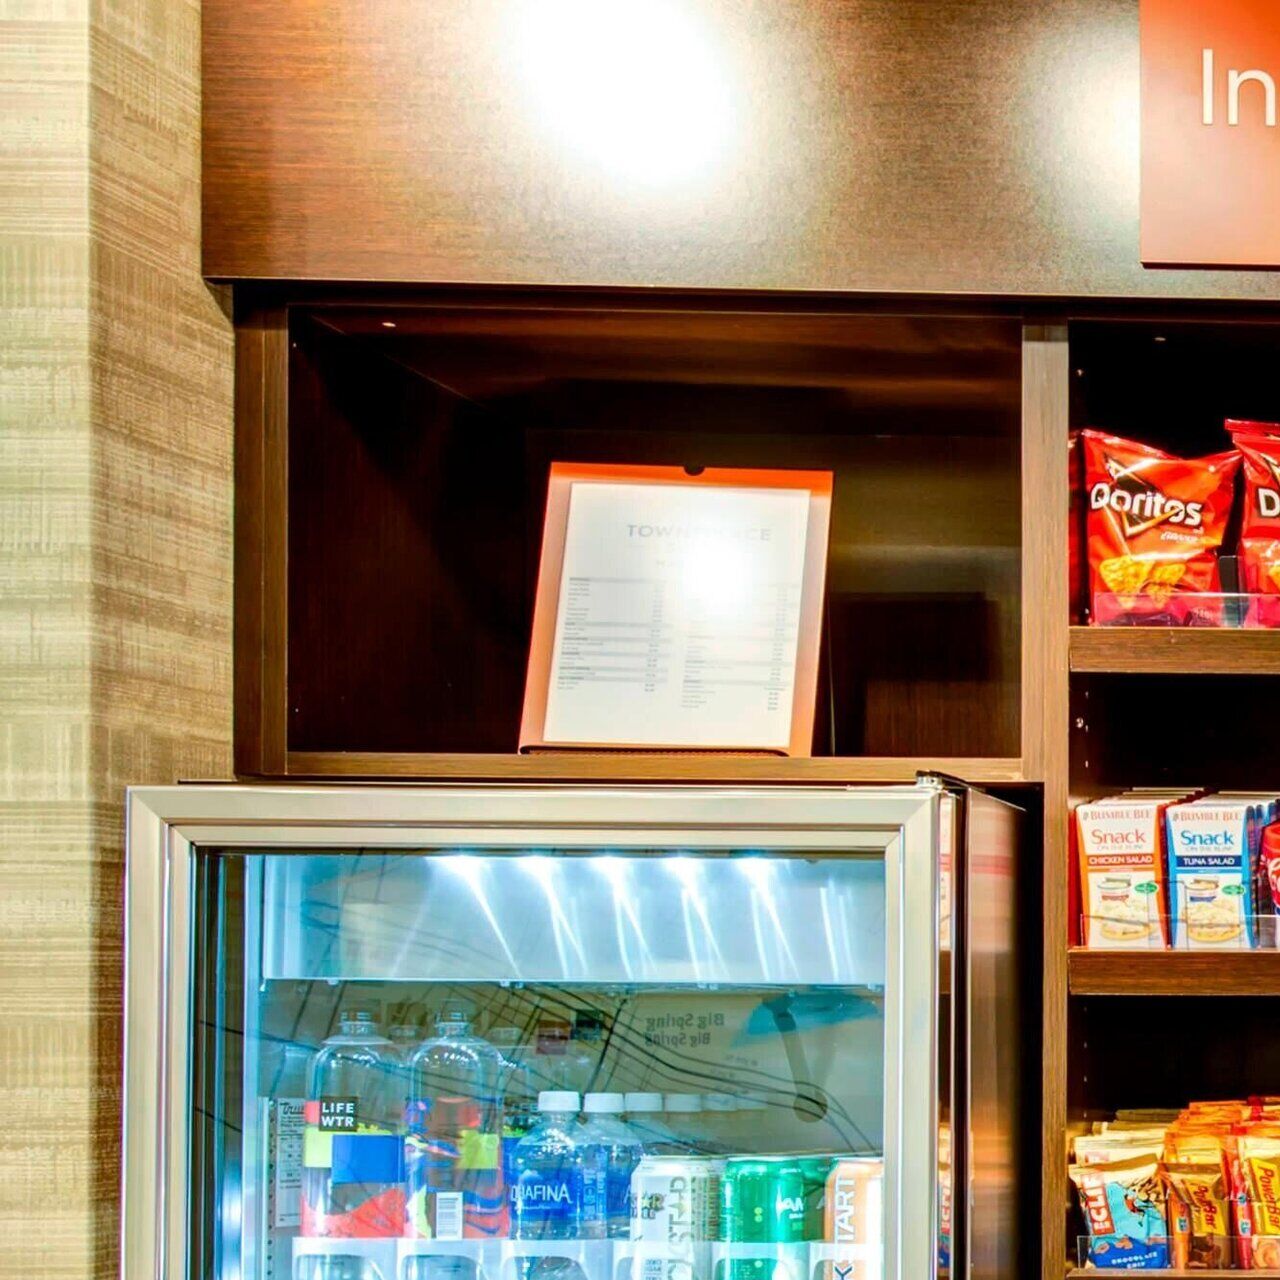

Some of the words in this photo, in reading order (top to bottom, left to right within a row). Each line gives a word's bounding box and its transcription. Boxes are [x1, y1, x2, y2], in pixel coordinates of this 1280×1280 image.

[1202, 48, 1276, 126] In
[1090, 482, 1203, 525] Doritos
[1091, 828, 1147, 845] Snack
[1181, 830, 1235, 846] Snack
[1089, 855, 1125, 865] CHICKEN
[1126, 855, 1154, 864] SALAD
[1183, 857, 1208, 865] TUNA
[1209, 857, 1236, 866] SALAD
[321, 1102, 355, 1115] LIFE
[321, 1115, 355, 1128] WTR
